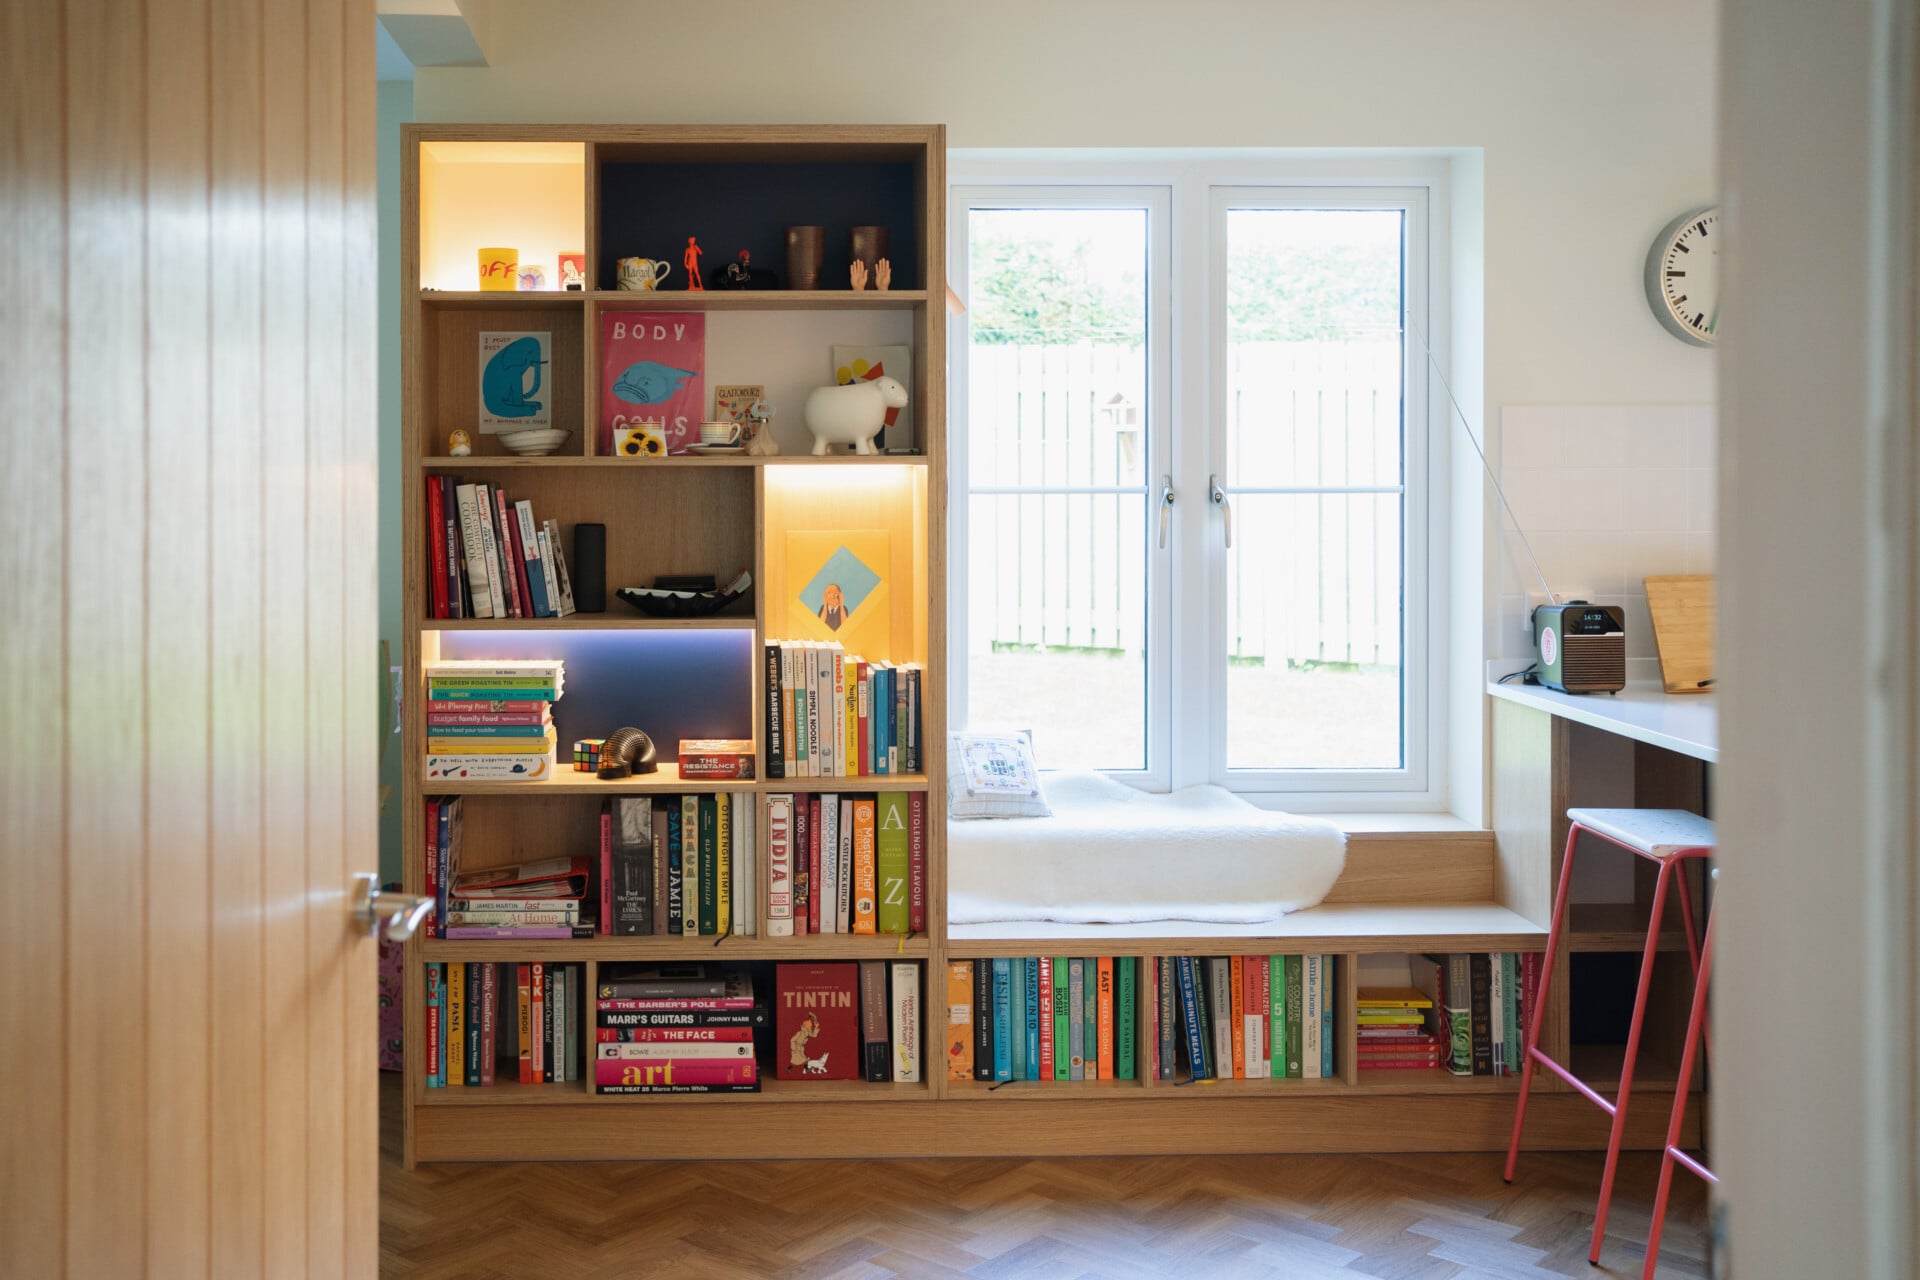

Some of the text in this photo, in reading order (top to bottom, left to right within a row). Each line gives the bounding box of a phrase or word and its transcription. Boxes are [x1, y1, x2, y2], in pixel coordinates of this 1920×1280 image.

[480, 261, 517, 278] OFF
[613, 322, 686, 341] BODY
[461, 502, 478, 562] COOKBOOK
[472, 518, 484, 561] COMPLETE
[835, 654, 843, 694] mob 6
[458, 715, 481, 723] family
[770, 691, 779, 732] BARBECUE
[772, 733, 780, 755] BIBLE
[810, 719, 818, 755] NOODLES
[797, 815, 806, 833] 1000
[880, 804, 906, 830] A
[721, 805, 729, 905] OTTOLENGHI SIMPLE
[772, 816, 788, 883] INDIA
[828, 802, 837, 888] GORDON RAMSAY'S
[842, 837, 850, 861] CASTLE
[855, 828, 863, 865] KITCHEN
[863, 827, 874, 892] MasterChef
[912, 801, 921, 907] OTTOLENGHI FLAVOUR
[670, 812, 681, 919] SAVE JAMIE
[840, 884, 849, 913] KITCHEN
[884, 877, 905, 906] Z
[509, 913, 558, 923] At Home
[429, 968, 438, 1001] OTK
[533, 964, 542, 997] OTK
[1308, 956, 1318, 985] jamie
[471, 980, 481, 1024] family food
[484, 963, 492, 1032] Family Comforts
[783, 992, 851, 1007] TINTIN
[1028, 961, 1037, 1030] RAMSAY IN 10
[1262, 961, 1270, 1015] INSPIRALIZED
[1293, 985, 1301, 1022] COUNTRY
[452, 1002, 460, 1032] PASTA
[607, 1015, 648, 1024] MARR'S
[650, 1015, 694, 1024] GUITARS
[996, 973, 1008, 1060] FISH SHELLFISH
[1041, 957, 1050, 1064] JAMIE'S MINUTE MEALS
[1181, 957, 1201, 1065] JAMIE'S 30-MINUTE MEALS
[1274, 1003, 1283, 1016] 5
[1309, 994, 1317, 1017] home
[900, 1026, 908, 1045] Poetry
[908, 1019, 916, 1052] Anthology
[622, 1058, 675, 1085] art
